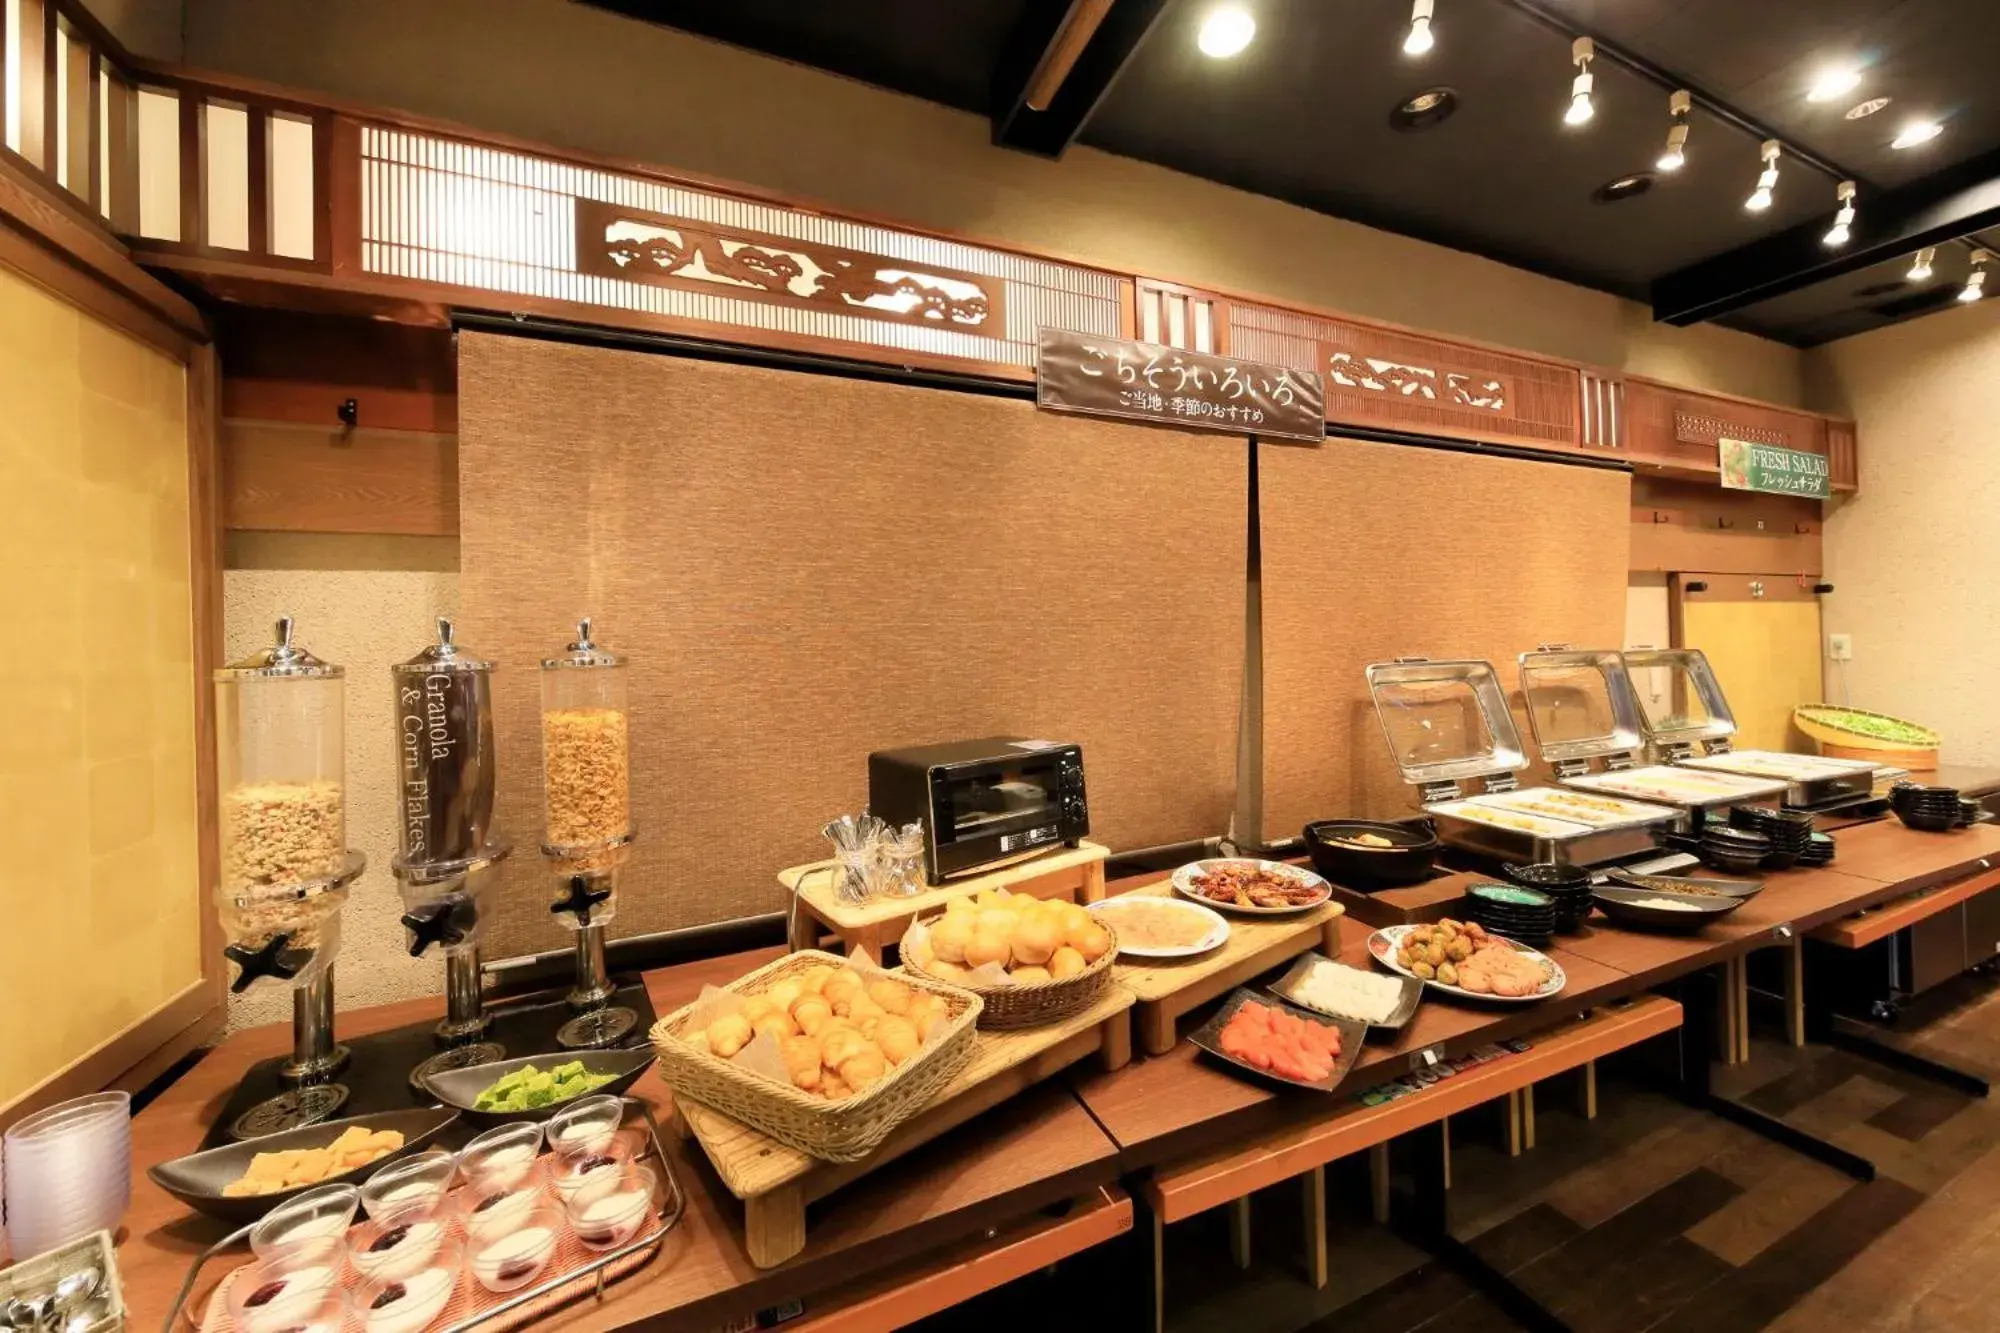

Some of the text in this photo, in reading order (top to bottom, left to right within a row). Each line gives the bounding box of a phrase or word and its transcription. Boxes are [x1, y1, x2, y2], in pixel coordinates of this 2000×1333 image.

[1080, 345, 1293, 406] ごちそういろいろ
[1752, 449, 1829, 476] FRESH SALAD
[1761, 472, 1822, 491] フレッシュサラダ
[425, 674, 456, 760] Granola
[402, 687, 430, 853] & Corn Flakes
